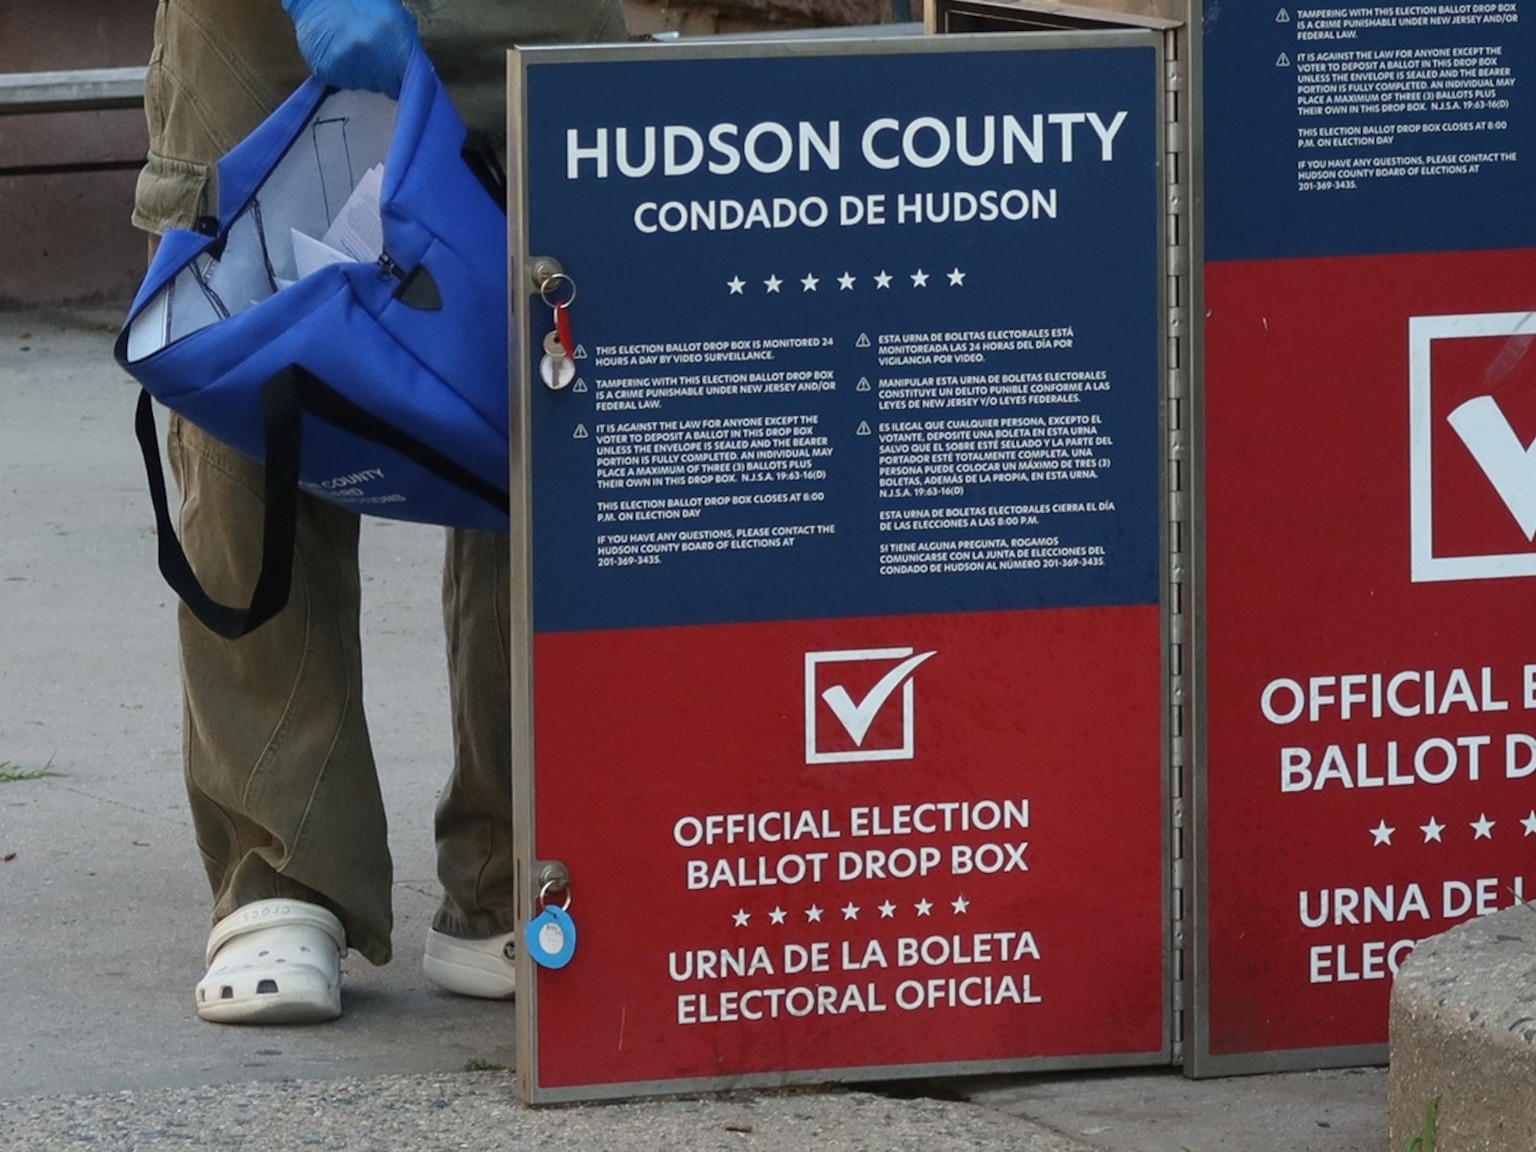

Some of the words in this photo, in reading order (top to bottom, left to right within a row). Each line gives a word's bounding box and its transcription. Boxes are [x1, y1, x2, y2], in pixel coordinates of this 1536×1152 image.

[567, 121, 839, 178] HUDSON
[862, 112, 1127, 169] COUNTY
[1317, 138, 1332, 147] ON
[1333, 136, 1375, 147] ELECTION
[1376, 136, 1394, 145] DAY
[1298, 161, 1306, 170] IF
[1308, 160, 1327, 169] YOU
[1328, 159, 1351, 168] HAVE
[1353, 158, 1372, 167] ANY
[1426, 155, 1457, 164] PLEASE
[1458, 153, 1499, 163] CONTACT
[1501, 152, 1517, 161] THE
[1298, 170, 1336, 180] HUDSON
[1337, 169, 1374, 179] COUNTY
[1375, 168, 1406, 177] BOARD
[1407, 167, 1419, 176] OF
[1421, 165, 1468, 175] ELECTIONS
[1469, 164, 1479, 173] AT
[635, 197, 828, 233] CONDADO
[841, 195, 885, 225] DE
[898, 189, 1056, 223] HUDSON
[878, 335, 901, 344] ESTA
[902, 334, 929, 343] URNA
[930, 333, 943, 342] DE
[944, 332, 986, 342] BOLETAS
[987, 329, 1050, 340] ELECTORALES
[1051, 326, 1074, 338] ESTÁ
[596, 346, 617, 356] THIS
[618, 344, 665, 355] ELECTION
[666, 343, 701, 353] BALLOT
[703, 342, 730, 351] DROP
[730, 341, 751, 350] BOX
[752, 340, 761, 349] IS
[763, 338, 820, 349] MONITORED
[822, 337, 834, 346] 24
[878, 344, 949, 355] MONITOREADA
[950, 343, 967, 352] LAS
[969, 343, 981, 352] 24
[982, 342, 1015, 351] HORAS
[1016, 341, 1033, 350] DEL
[1035, 338, 1052, 349] DÍA
[1053, 339, 1073, 349] POR
[595, 357, 629, 367] HOURS
[639, 356, 657, 365] DAY
[659, 355, 672, 364] BY
[673, 354, 703, 363] VIDEO
[879, 356, 932, 366] VIGILANCIA
[933, 355, 953, 364] POR
[597, 378, 651, 389] TAMPERING
[652, 377, 678, 386] WITH
[680, 376, 701, 385] THIS
[702, 374, 748, 384] ELECTION
[749, 373, 784, 382] BALLOT
[786, 371, 813, 381] DROP
[814, 370, 834, 380] BOX
[596, 391, 605, 400] IS
[614, 390, 644, 399] CRIME
[646, 387, 704, 398] PUNISHABLE
[706, 386, 738, 395] UNDER
[739, 384, 763, 394] NEW
[765, 383, 796, 393] JERSEY
[596, 401, 636, 411] FEDERAL
[321, 468, 384, 490] COUNTY
[1261, 667, 1508, 724] OFFICIAL
[1281, 736, 1490, 792] BALLOT
[674, 810, 840, 846] OFFICIAL
[851, 799, 1028, 836] ELECTION
[688, 853, 828, 889] BALLOT
[839, 847, 940, 880] DROP
[952, 842, 1028, 874] BOX
[1299, 884, 1430, 929] URNA
[1442, 877, 1499, 919] DE
[669, 947, 774, 981] URNA
[785, 943, 829, 973] DE
[843, 940, 887, 969] LA
[898, 932, 1040, 966] BOLETA
[678, 983, 886, 1024] ELECTORAL
[896, 975, 1041, 1009] OFICIAL
